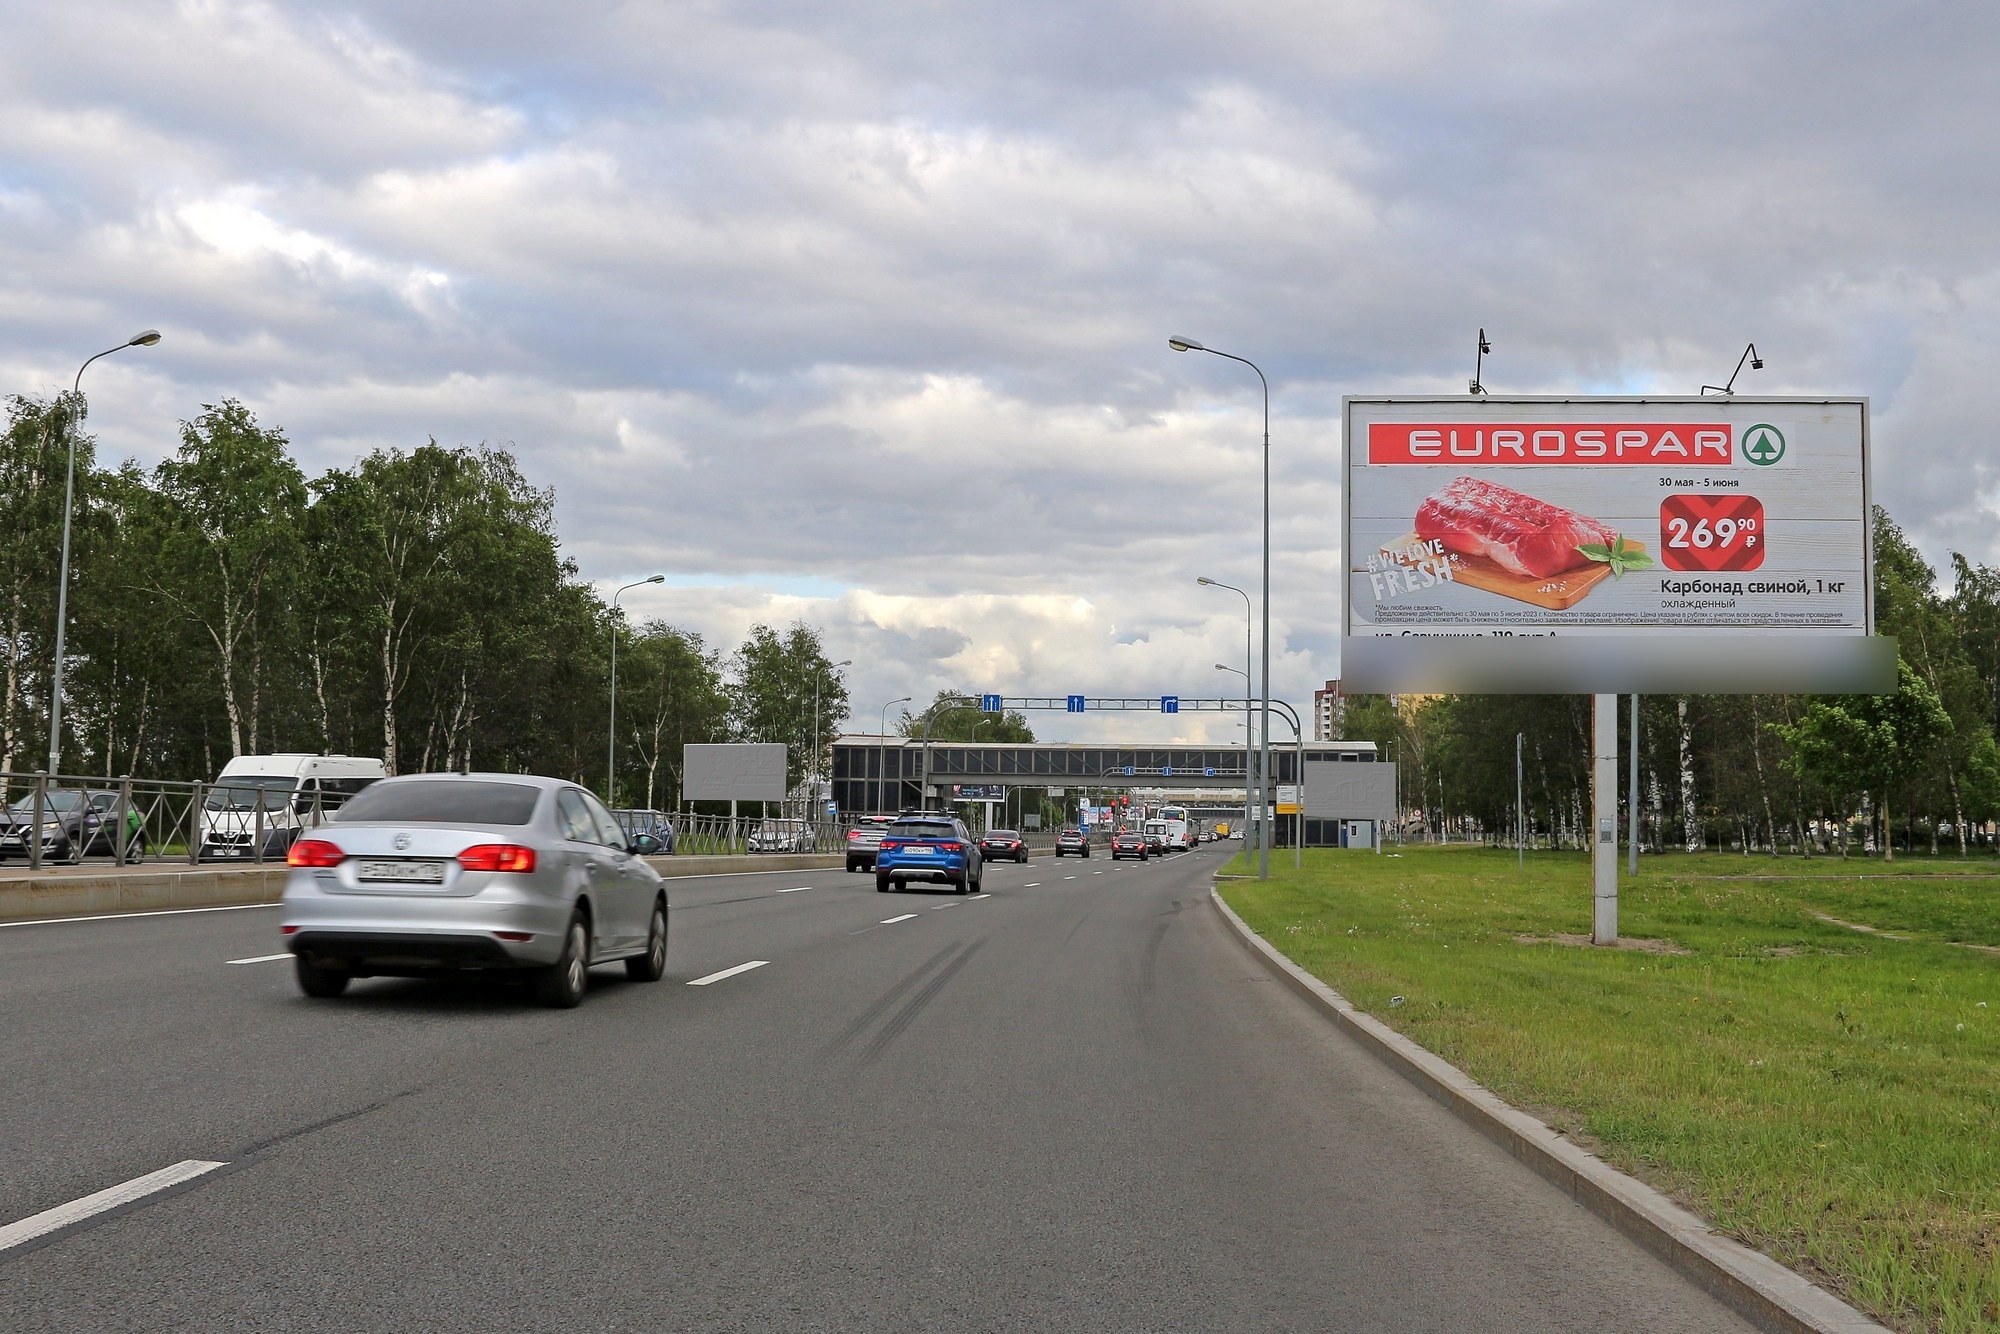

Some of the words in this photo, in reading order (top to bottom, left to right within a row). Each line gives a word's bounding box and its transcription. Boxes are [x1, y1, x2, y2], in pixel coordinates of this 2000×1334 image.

[1408, 430, 1728, 458] EUROSPAR
[1659, 477, 1672, 487] 30
[1674, 479, 1694, 487] мая
[1703, 477, 1710, 487] 5
[1712, 479, 1739, 487] июня
[1668, 517, 1737, 548] 269
[1737, 518, 1756, 531] 90
[1661, 579, 1743, 596] Карбонад
[1747, 578, 1811, 595] свиной,
[1816, 579, 1823, 593] 1
[1828, 581, 1845, 593] кг
[1661, 598, 1736, 609] охлажденный
